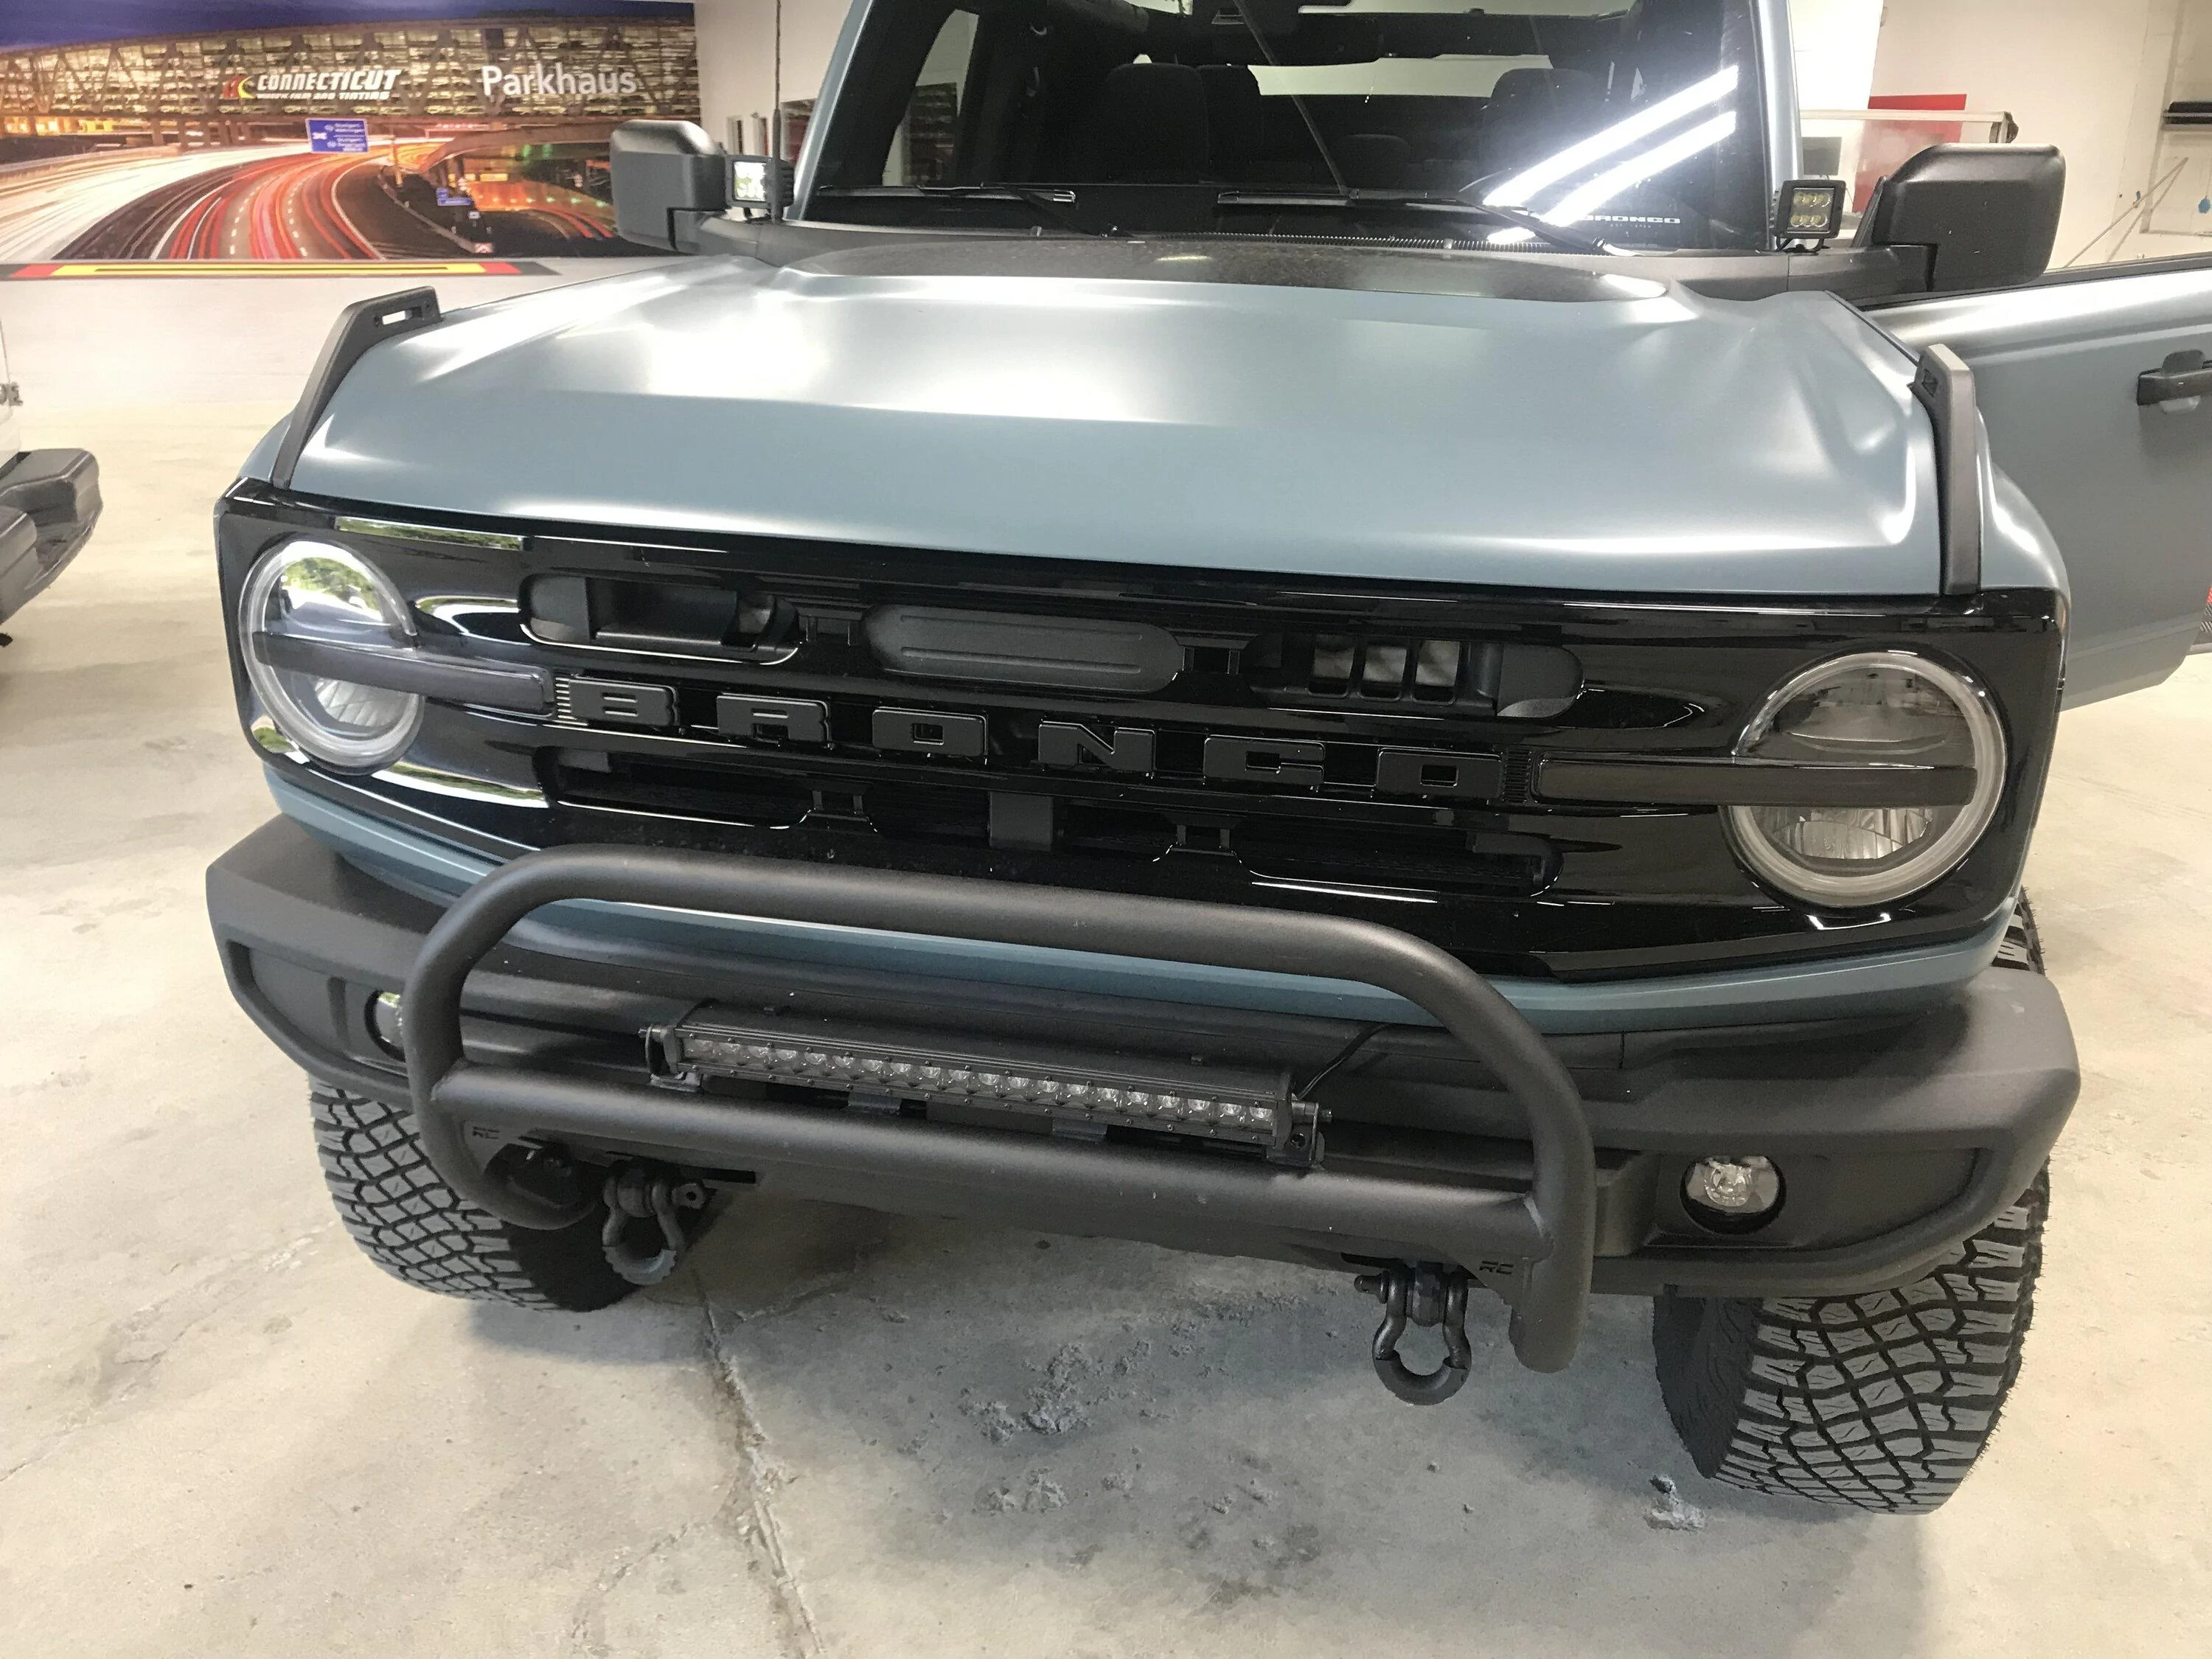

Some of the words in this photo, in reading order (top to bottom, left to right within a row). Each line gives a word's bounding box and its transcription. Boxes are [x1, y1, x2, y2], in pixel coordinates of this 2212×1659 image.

[257, 69, 402, 91] CONNECTICUT
[481, 61, 637, 97] Parkhaus
[568, 676, 1503, 797] BRONCO
